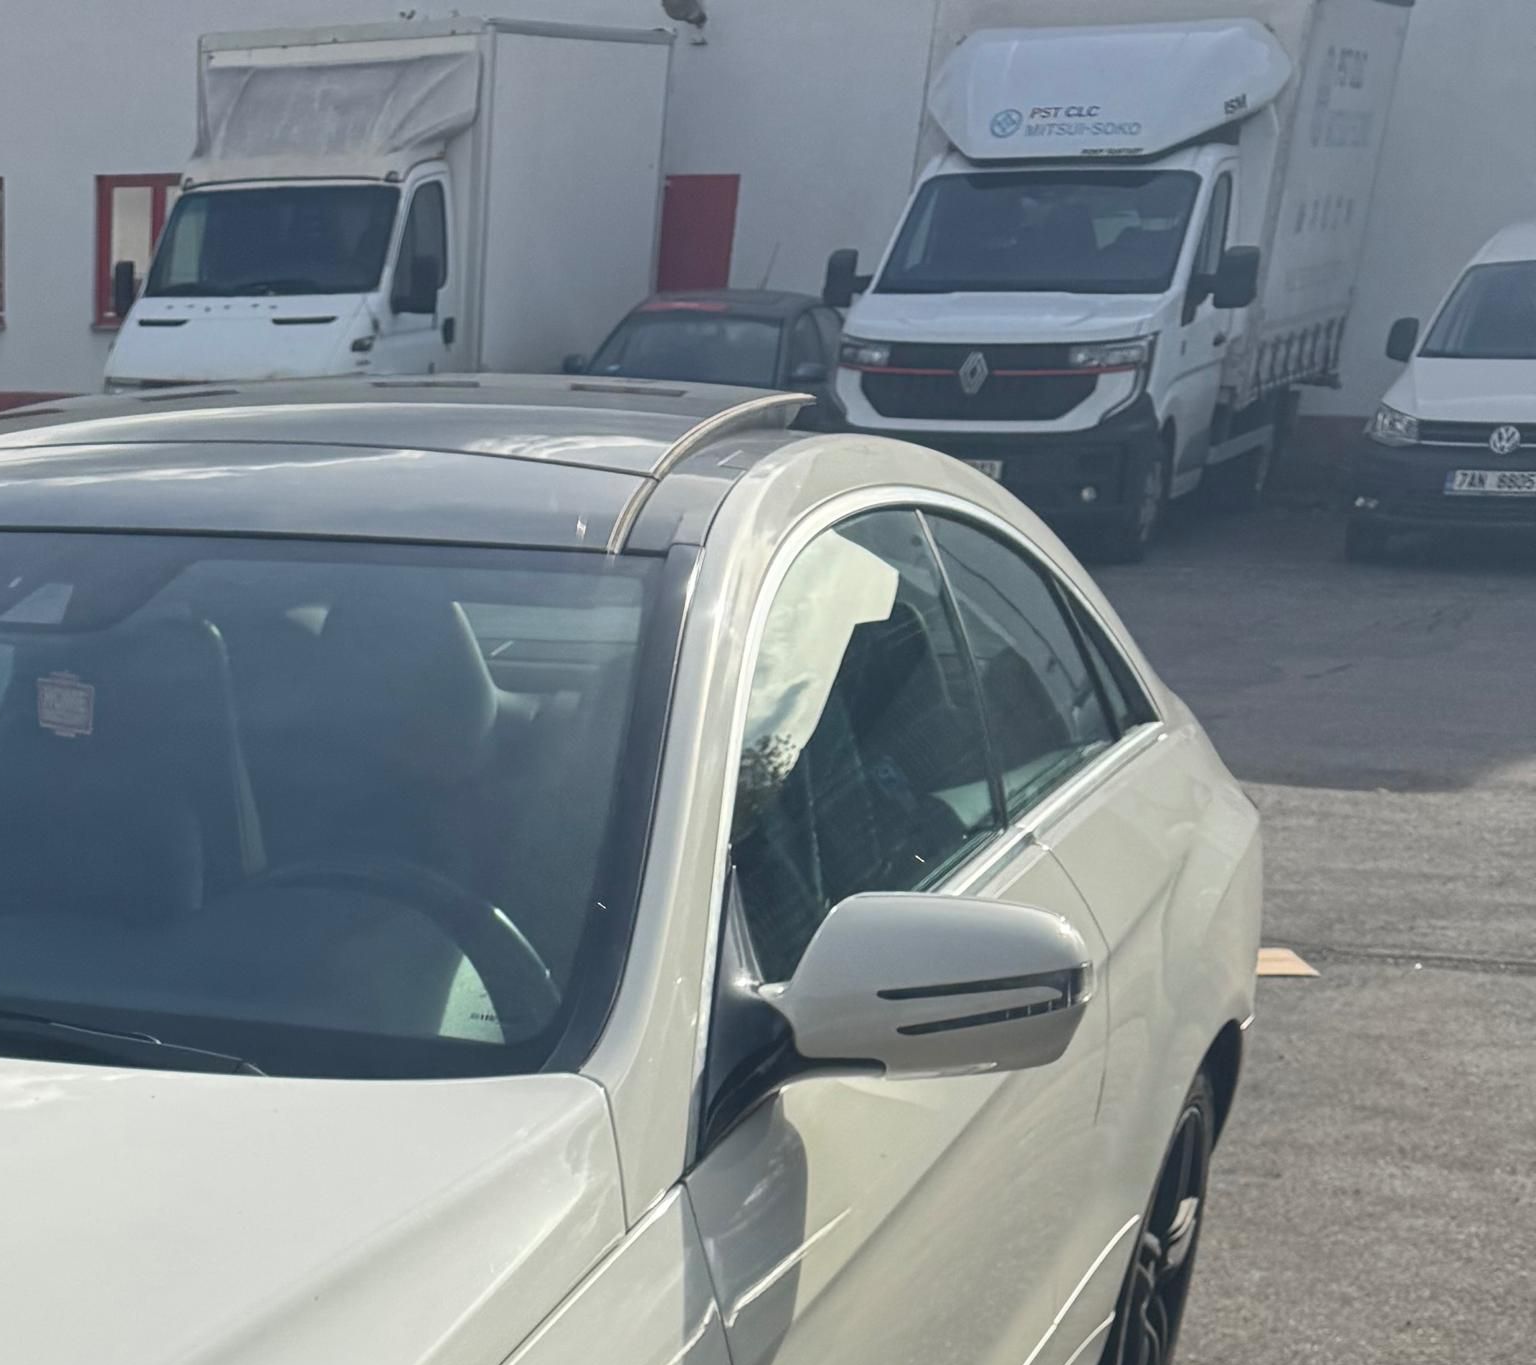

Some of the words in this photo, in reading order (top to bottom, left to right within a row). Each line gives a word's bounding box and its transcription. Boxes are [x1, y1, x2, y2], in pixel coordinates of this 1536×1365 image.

[1030, 107, 1063, 119] PST
[1064, 106, 1101, 118] CLC
[1025, 122, 1143, 137] MITSUI-SOKO
